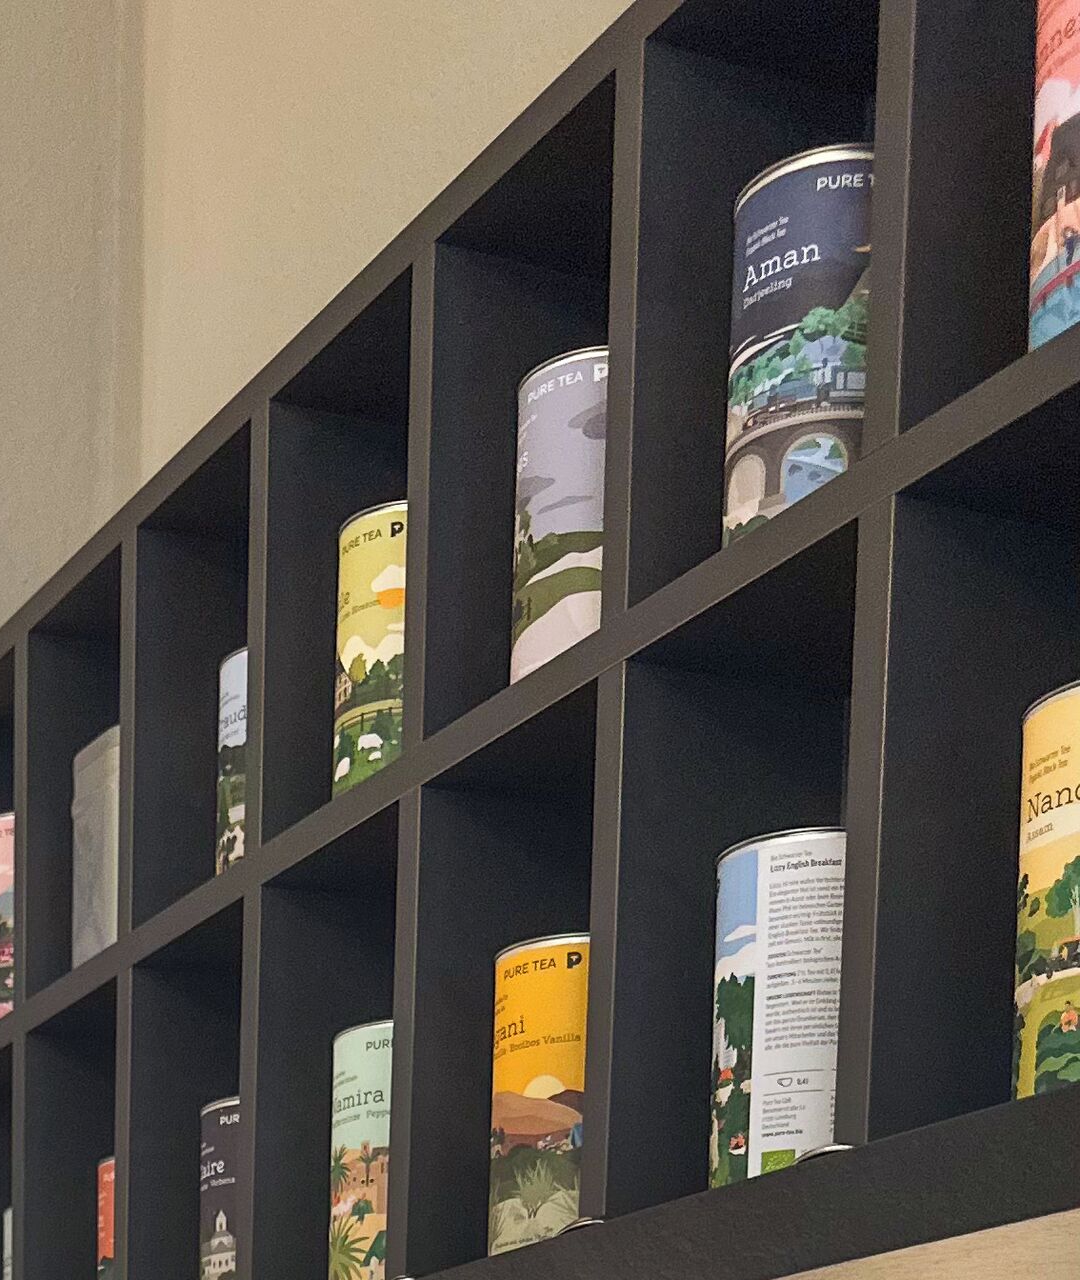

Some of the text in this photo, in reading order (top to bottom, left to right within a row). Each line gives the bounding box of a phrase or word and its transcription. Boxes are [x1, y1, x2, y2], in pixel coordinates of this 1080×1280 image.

[816, 173, 864, 191] PURE
[742, 243, 822, 293] Aman
[527, 379, 556, 404] PURE
[556, 370, 584, 388] TEA
[362, 528, 383, 543] TEA
[503, 962, 530, 981] PURE
[532, 958, 557, 971] TEA
[365, 1039, 393, 1052] PUR
[333, 1088, 385, 1115] amira
[219, 1113, 240, 1126] PUR
[200, 1160, 225, 1181] aire
